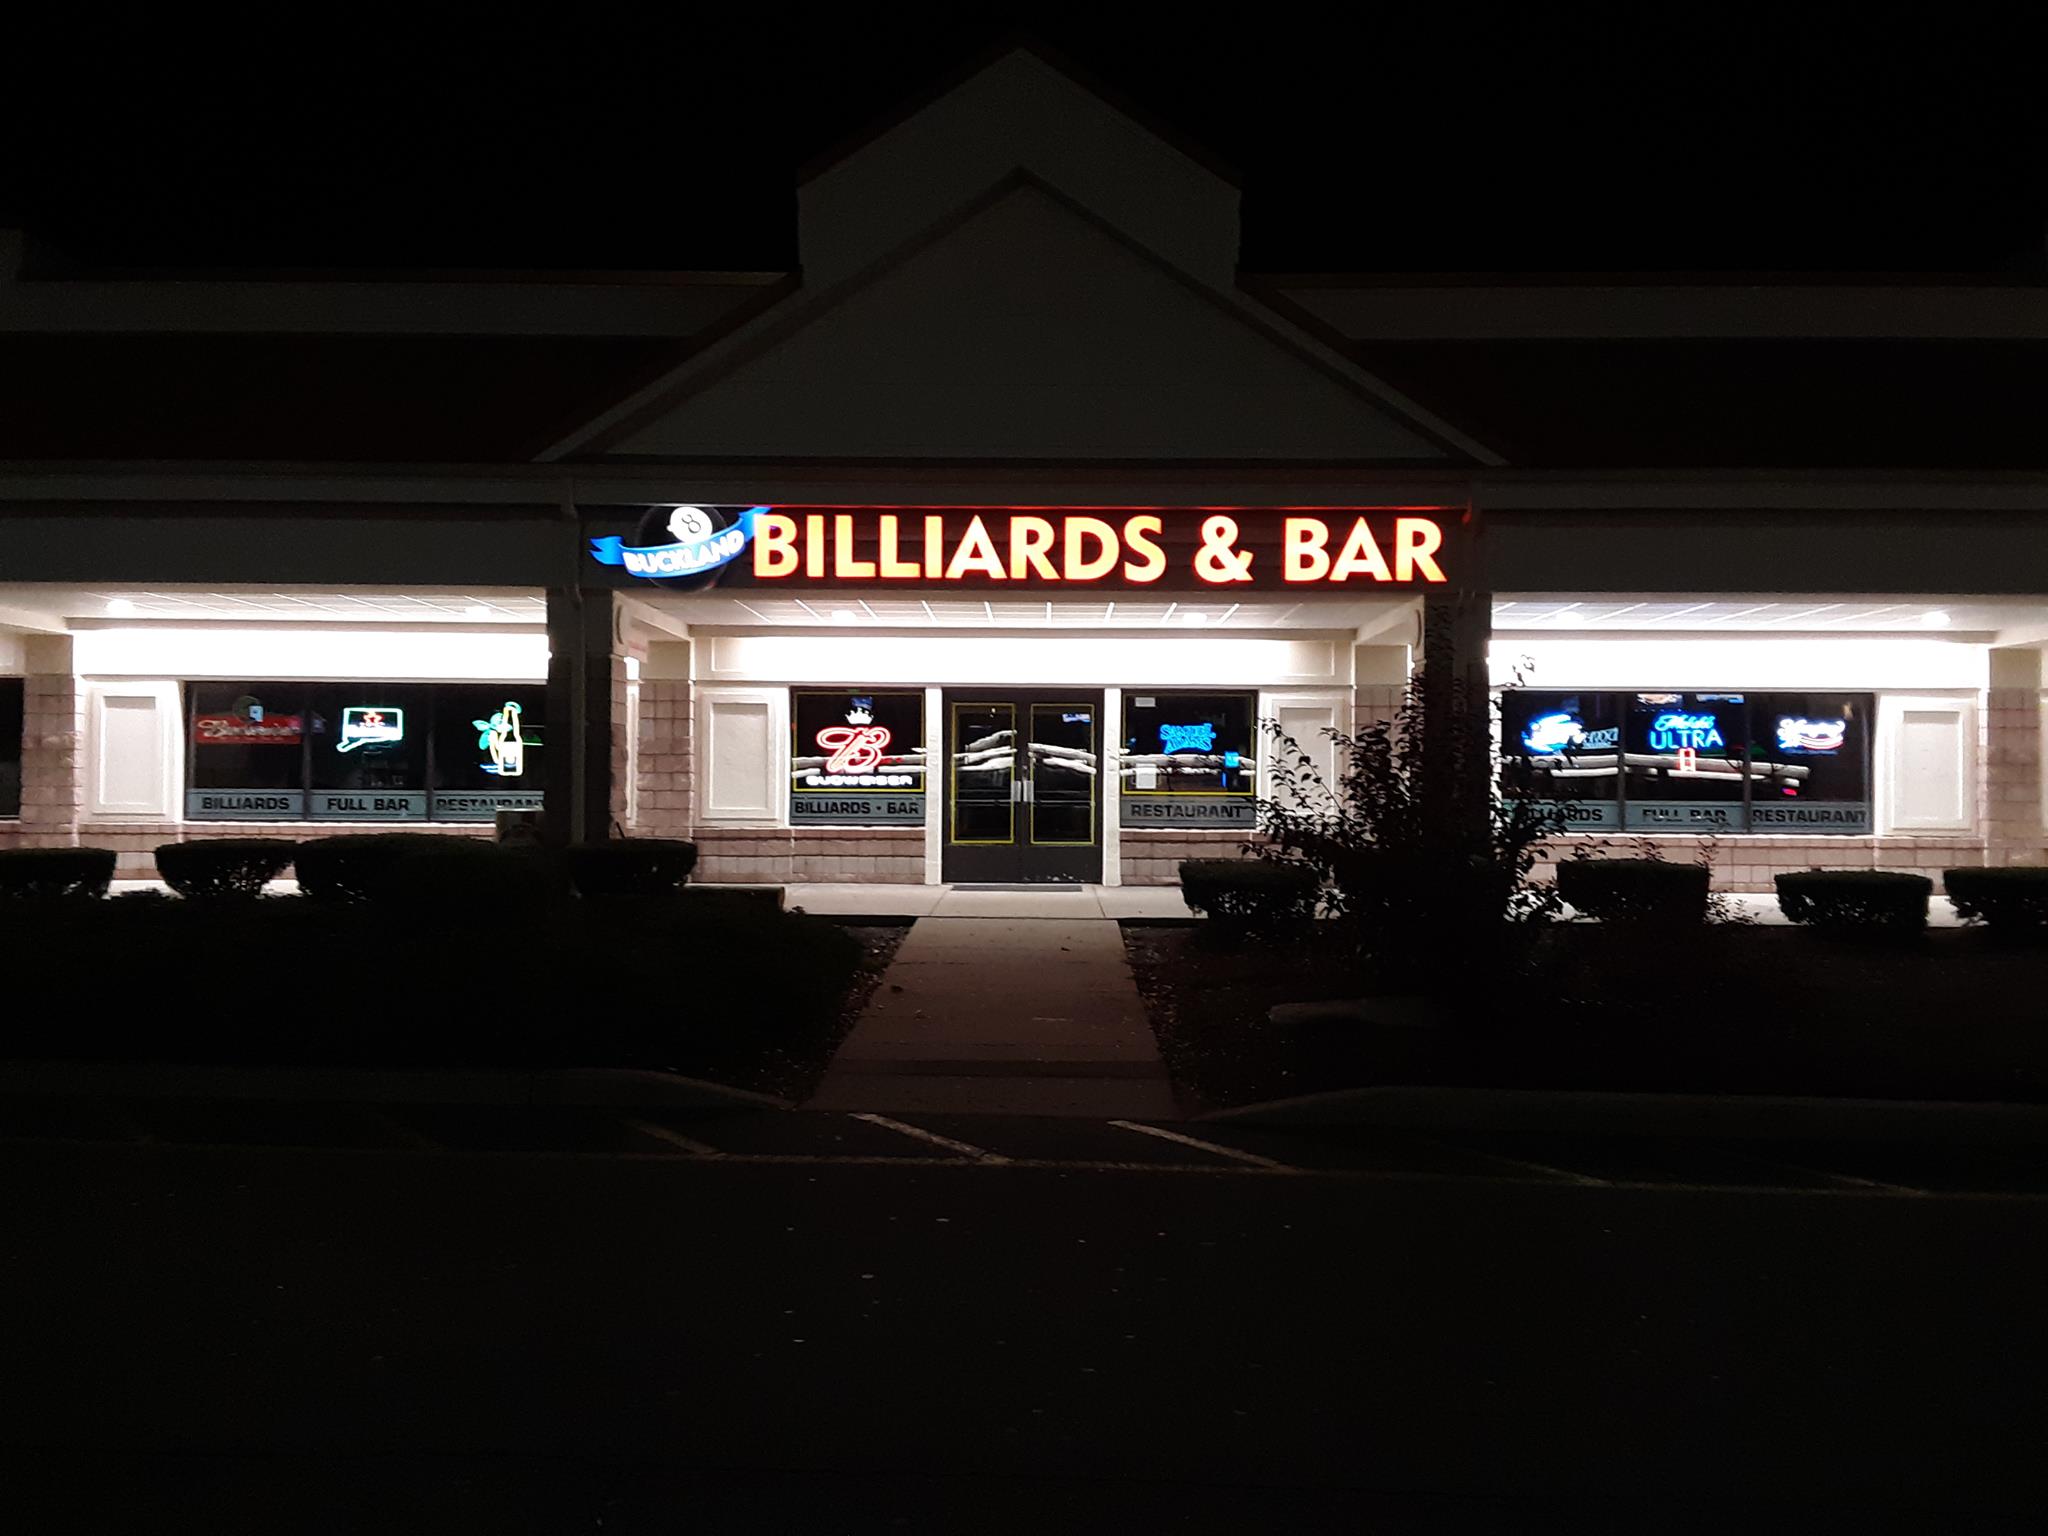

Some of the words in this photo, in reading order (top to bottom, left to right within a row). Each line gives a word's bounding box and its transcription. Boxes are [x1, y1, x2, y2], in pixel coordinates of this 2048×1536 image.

[681, 513, 702, 534] 8
[622, 529, 745, 574] BUCKLAND
[753, 513, 1167, 583] BILLIARDS
[1193, 514, 1254, 584] &
[1283, 516, 1447, 585] BAR
[1650, 728, 1724, 749] ULTRA
[202, 797, 290, 811] BILLIARDS
[327, 799, 367, 811] FULL
[374, 799, 410, 812] BAR
[795, 802, 871, 814] BILLIARDS
[887, 802, 919, 814] BAR
[1131, 804, 1242, 818] RESTAURANT
[1752, 809, 1867, 823] RESTAURANT
